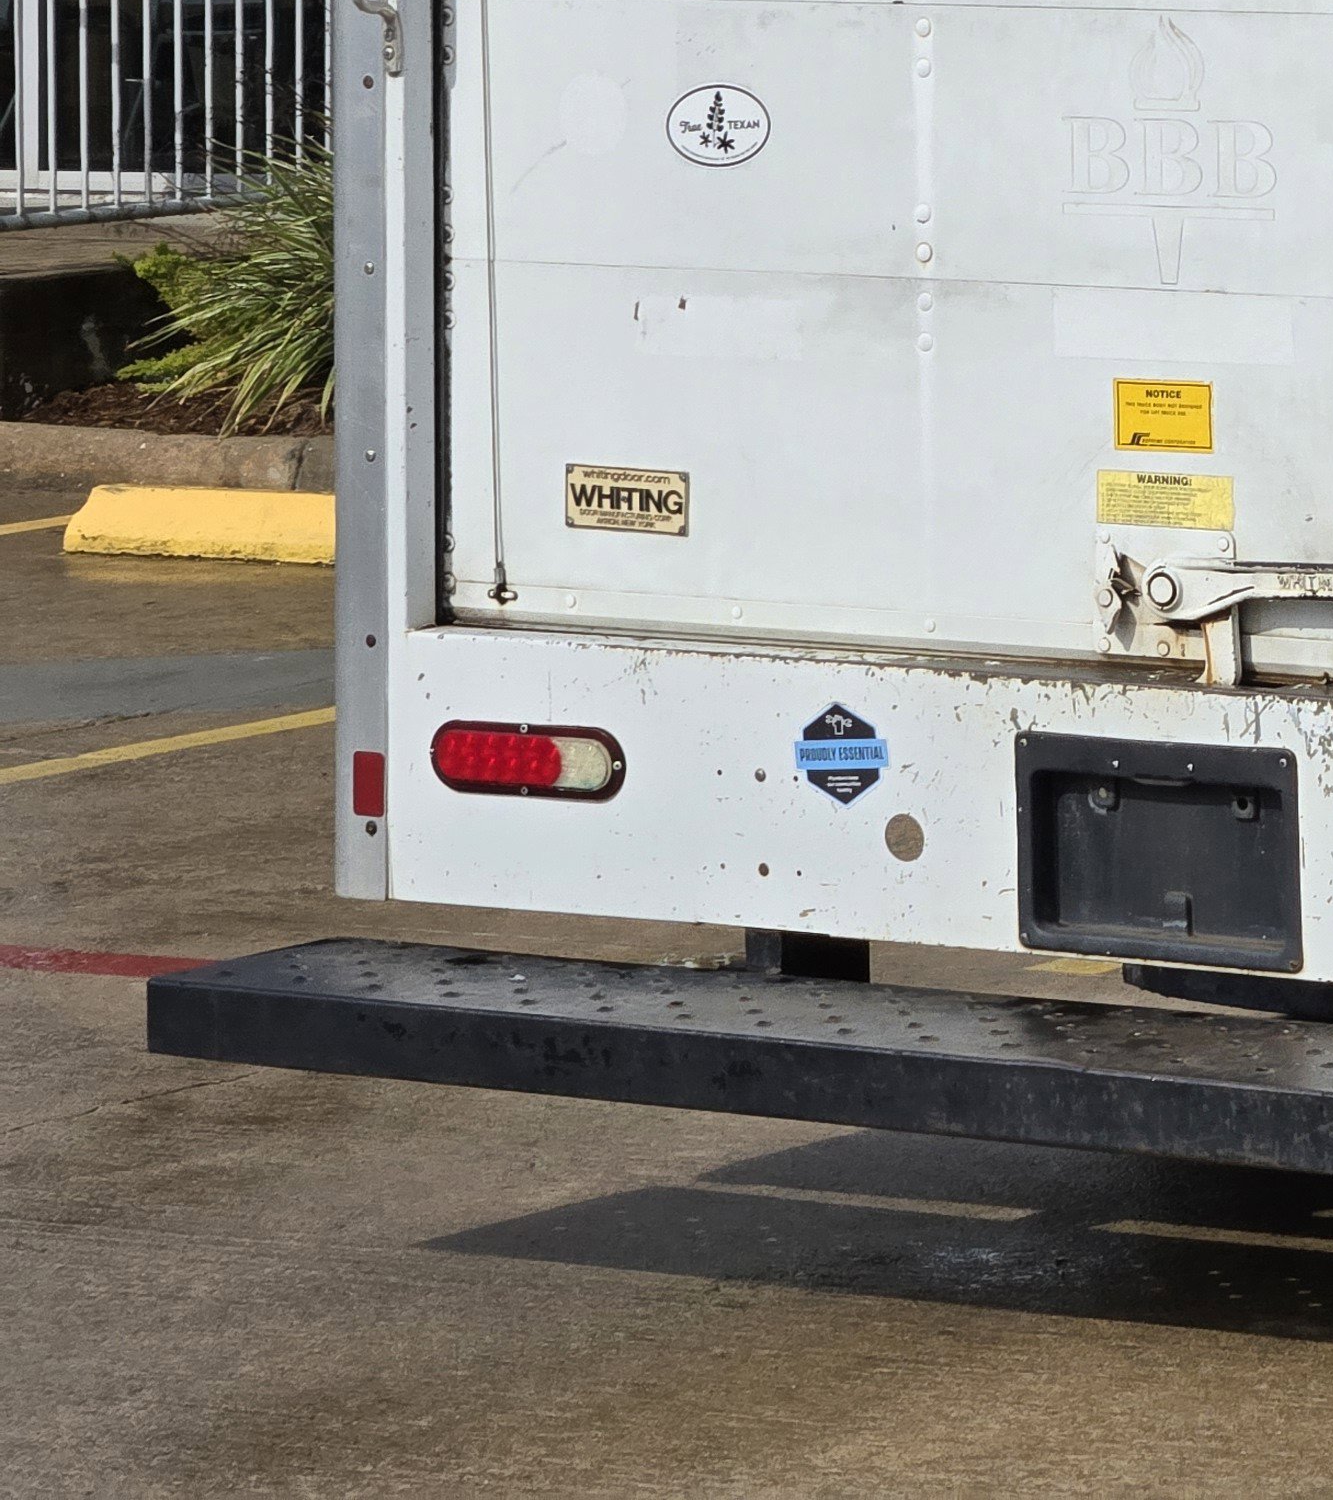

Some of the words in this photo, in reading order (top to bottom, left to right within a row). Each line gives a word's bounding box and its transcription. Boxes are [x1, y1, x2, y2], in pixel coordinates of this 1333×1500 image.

[727, 119, 761, 130] TEXAN
[1061, 115, 1278, 199] BBB
[1145, 389, 1182, 399] NOTICE
[582, 468, 671, 485] whitingdoor.com
[569, 482, 684, 515] WHITING
[800, 747, 837, 761] PROUDLY
[838, 745, 885, 761] ESSENTIAL
